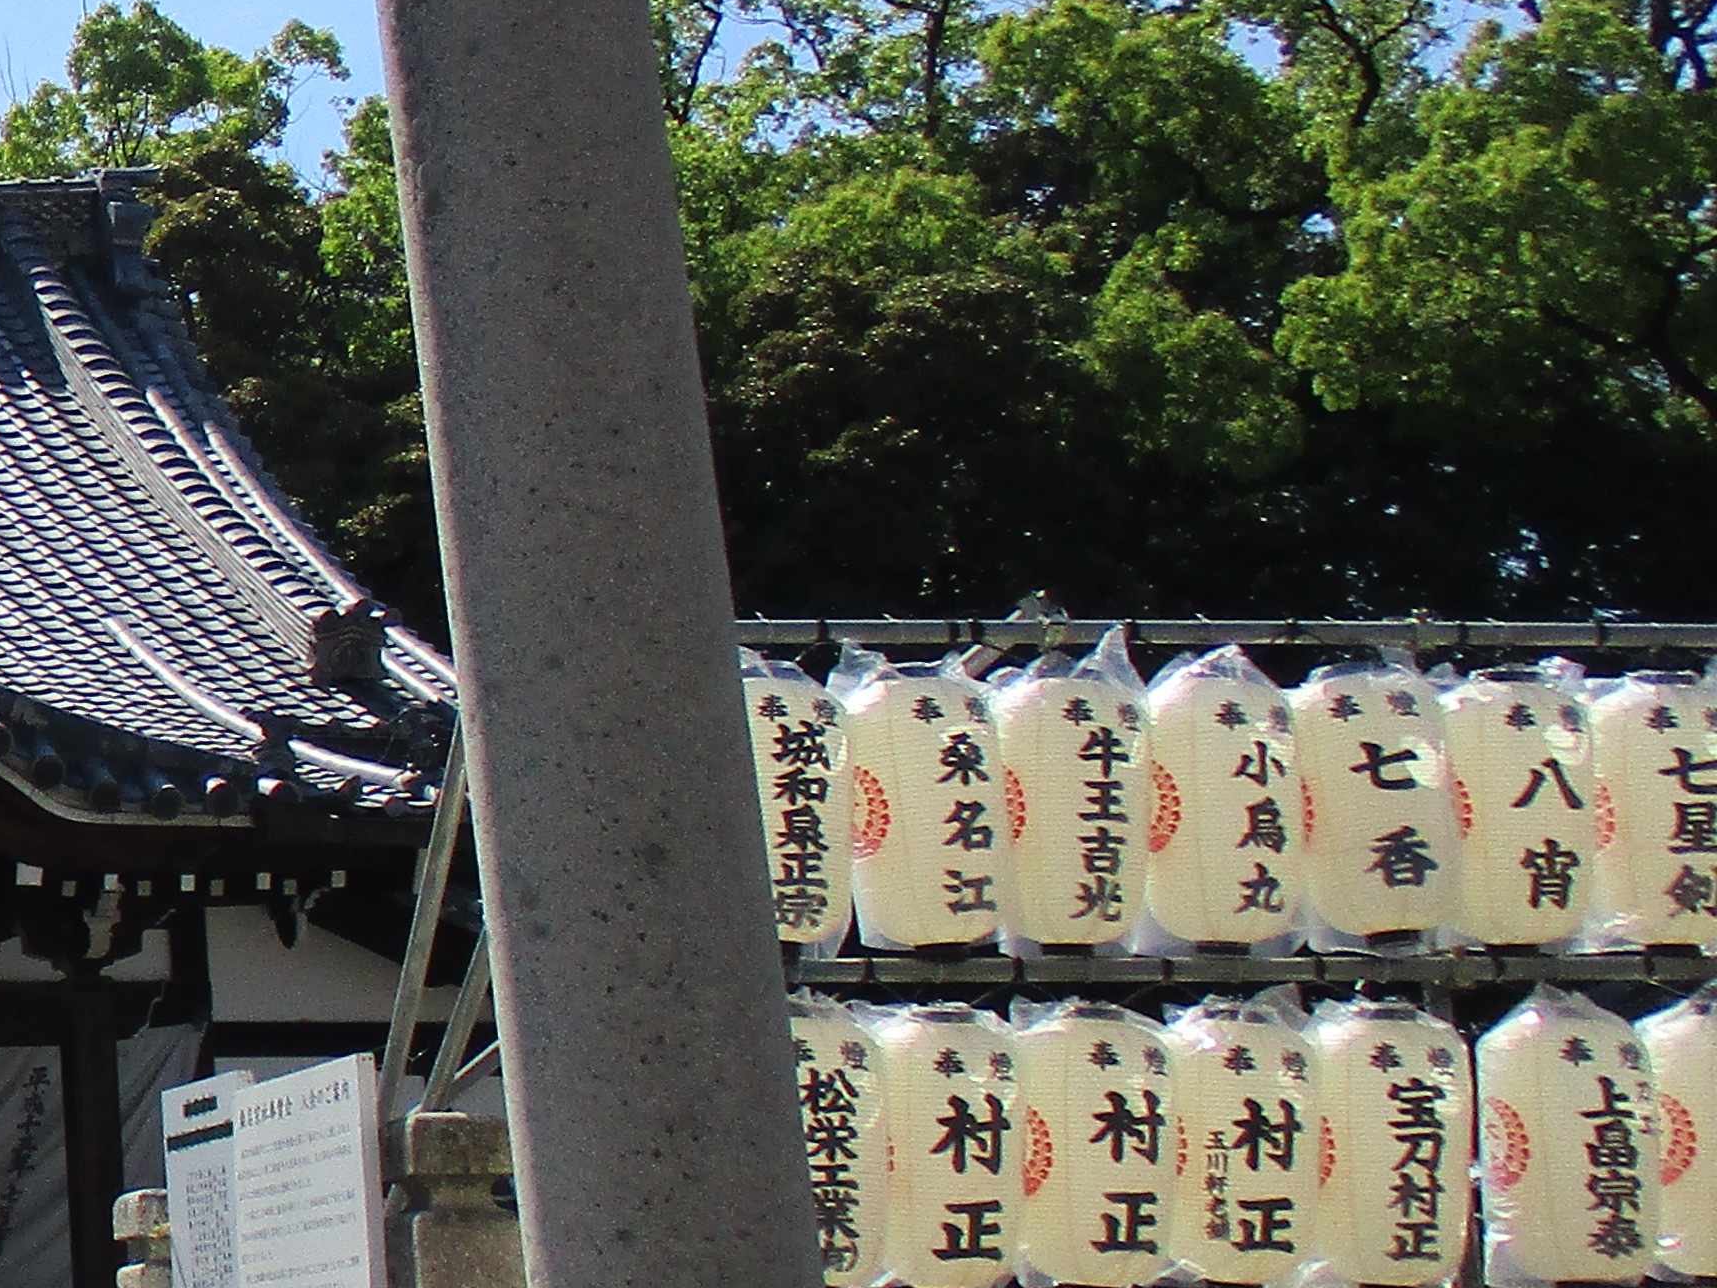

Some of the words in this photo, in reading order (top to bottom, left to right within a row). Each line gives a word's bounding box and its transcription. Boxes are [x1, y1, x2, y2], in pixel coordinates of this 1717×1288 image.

[771, 720, 833, 929] 城和泉正宗
[936, 733, 998, 916] 桑名江
[1068, 726, 1131, 923] 牛王吉光
[1348, 740, 1439, 889] 七香
[1510, 757, 1586, 910] 八宵
[930, 1093, 1013, 1262] 村正
[1088, 1089, 1167, 1256] 村正
[1231, 1096, 1303, 1255] 村正
[1385, 1077, 1447, 1262] 宝刀村正
